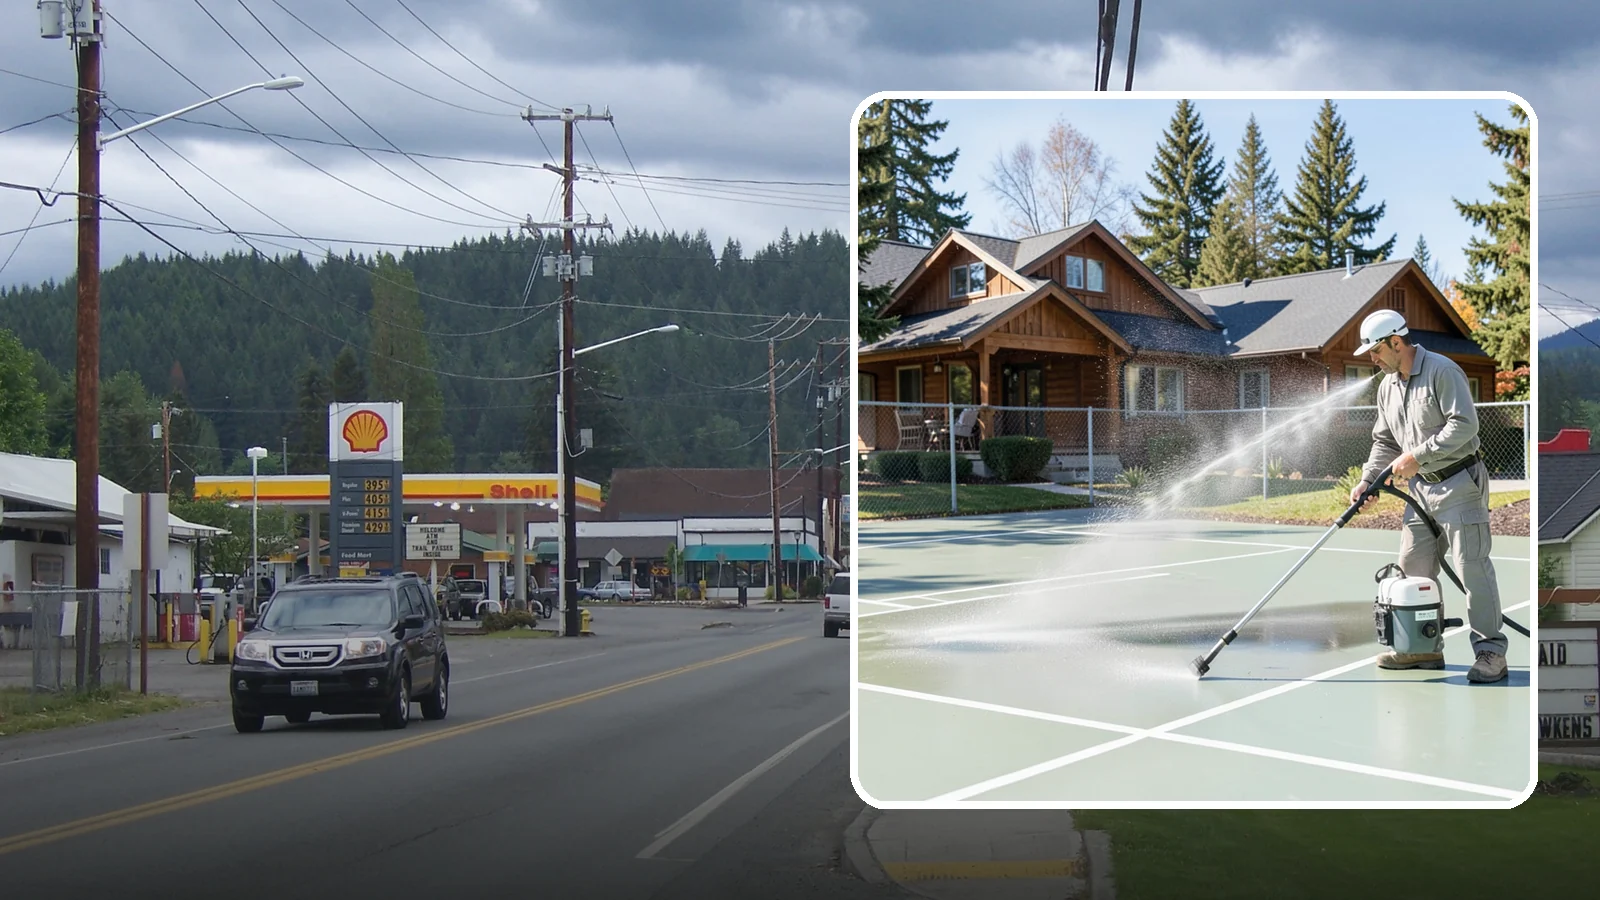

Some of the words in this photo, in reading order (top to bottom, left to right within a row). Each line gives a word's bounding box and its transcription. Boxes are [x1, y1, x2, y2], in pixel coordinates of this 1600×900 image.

[366, 480, 383, 490] 395
[490, 484, 547, 499] Shell
[366, 494, 383, 504] 405
[366, 508, 383, 518] 415
[366, 522, 383, 532] 429
